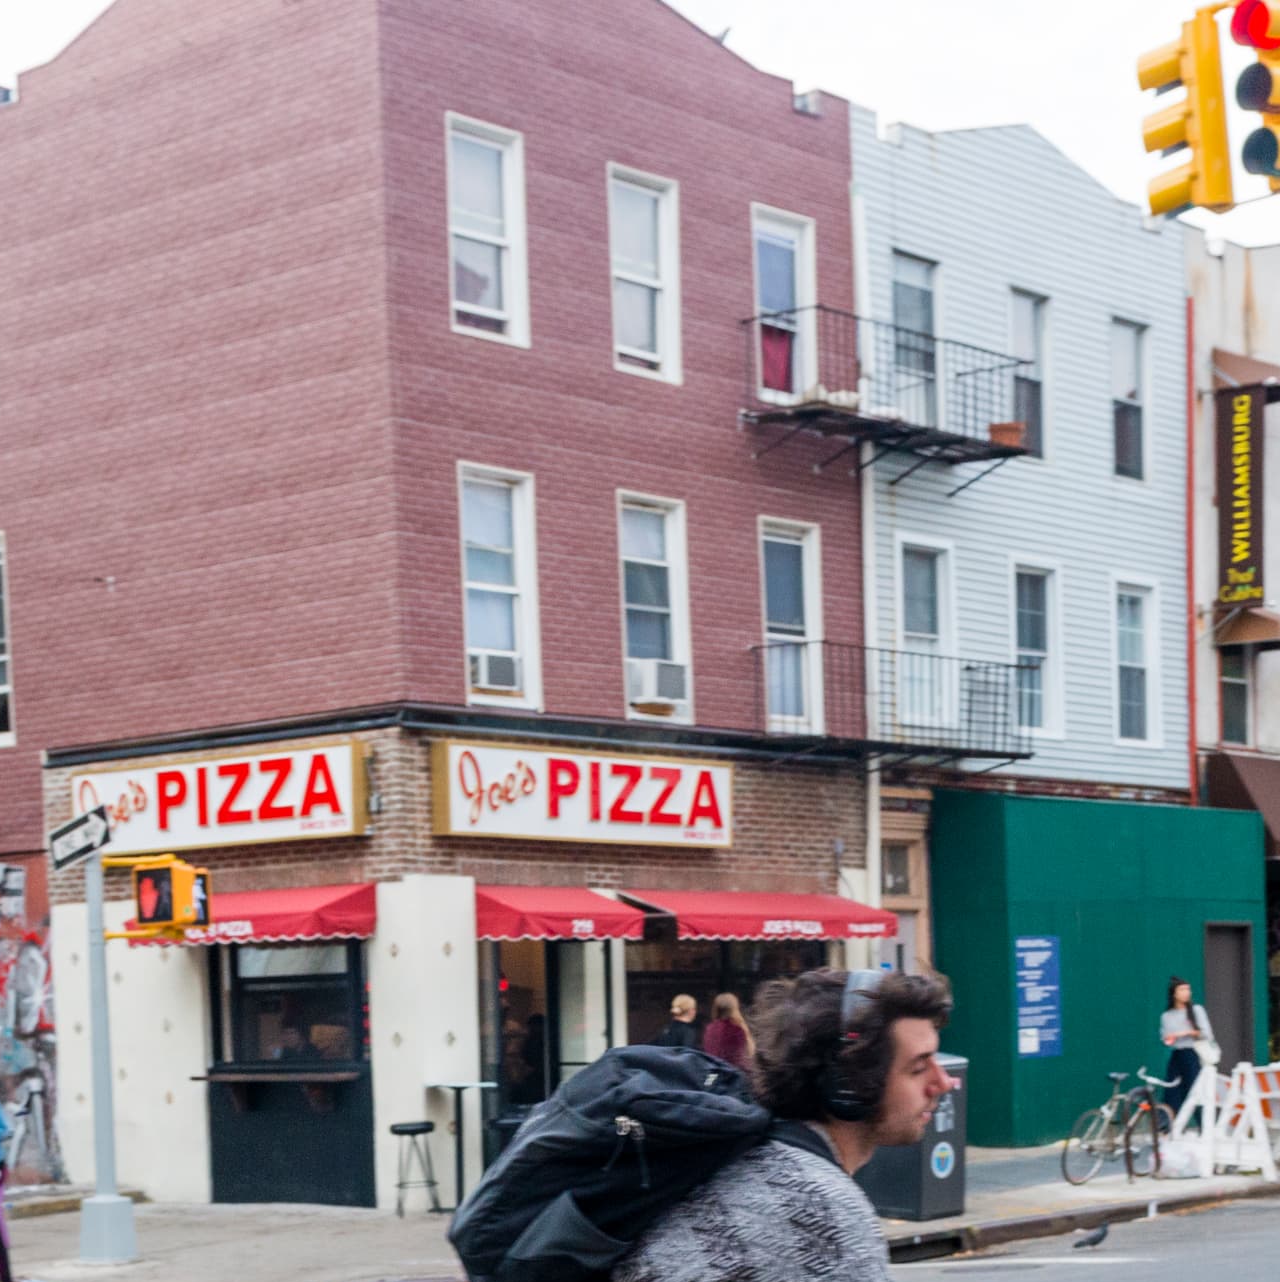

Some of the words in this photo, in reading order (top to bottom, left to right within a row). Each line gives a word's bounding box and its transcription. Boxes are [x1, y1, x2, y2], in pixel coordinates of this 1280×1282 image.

[1231, 394, 1252, 564] WILLIAMSBURG
[155, 753, 343, 831] PIZZA
[458, 751, 537, 825] Joe's
[547, 757, 723, 829] PIZZA
